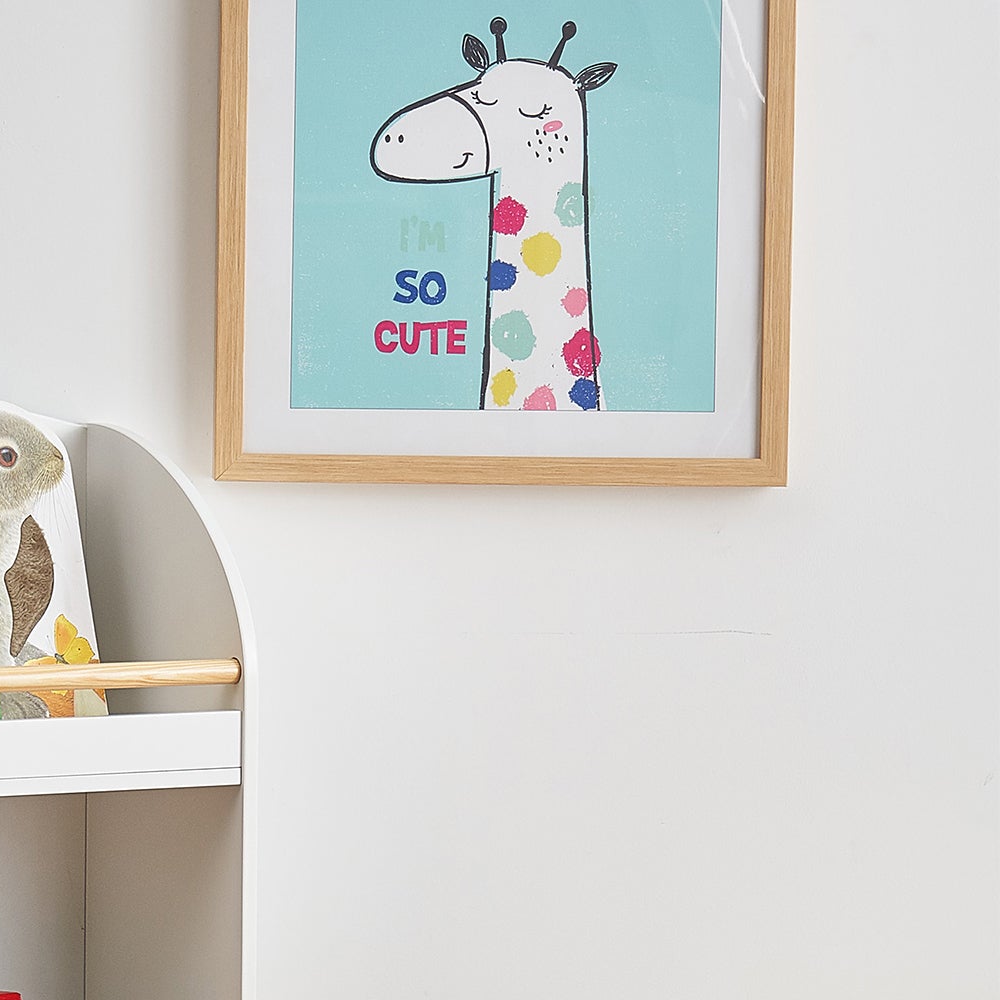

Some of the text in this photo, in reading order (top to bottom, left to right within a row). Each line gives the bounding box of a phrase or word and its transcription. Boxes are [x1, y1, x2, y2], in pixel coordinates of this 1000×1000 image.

[400, 215, 446, 251] I'M
[393, 269, 447, 306] SO
[374, 320, 468, 355] CUTE
